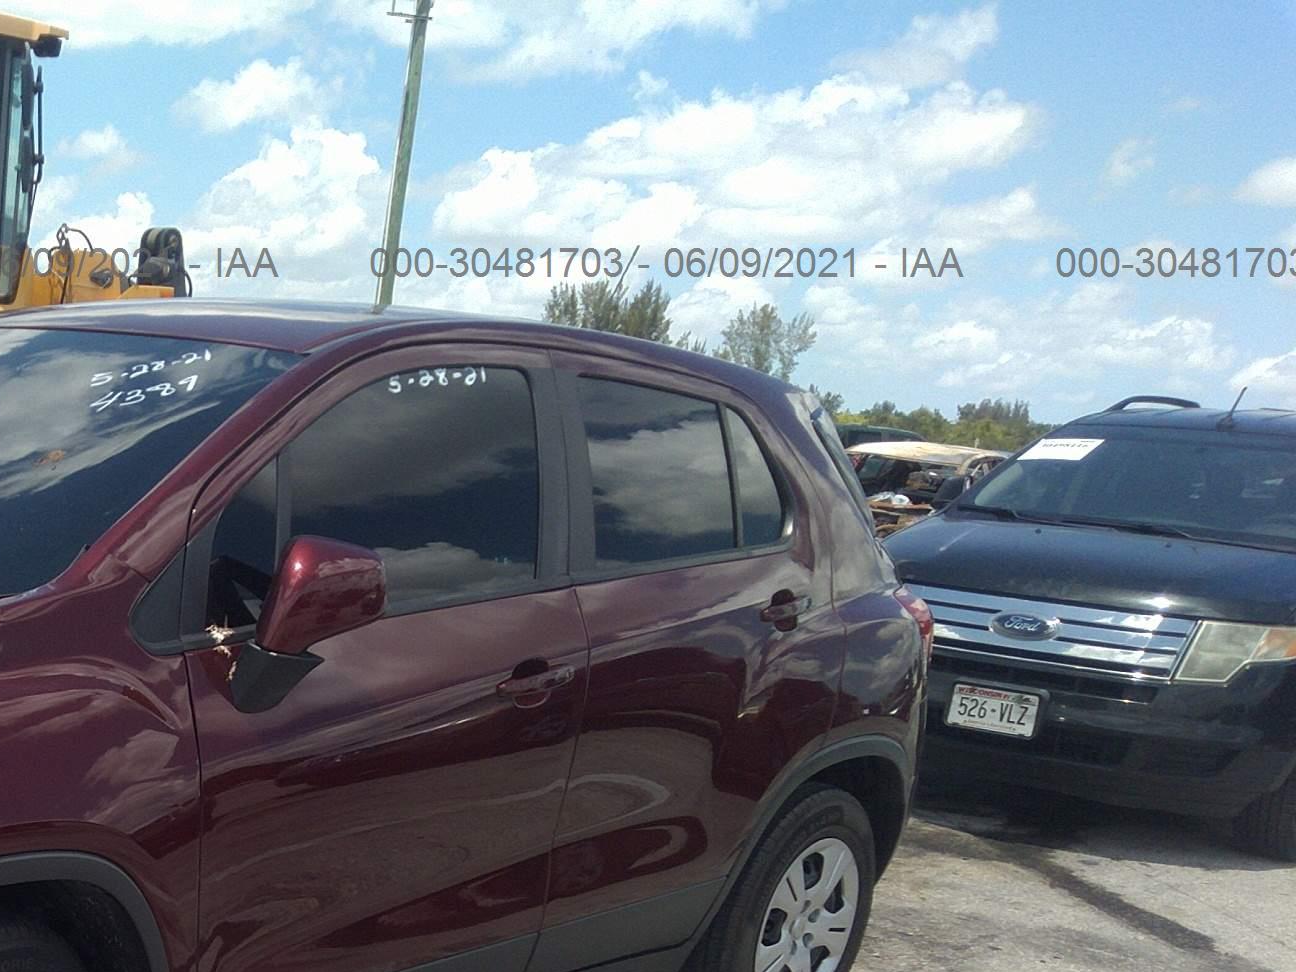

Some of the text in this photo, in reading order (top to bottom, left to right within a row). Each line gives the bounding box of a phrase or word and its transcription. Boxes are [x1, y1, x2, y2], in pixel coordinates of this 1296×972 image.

[89, 374, 199, 413] 4389
[1004, 615, 1041, 632] Ford
[957, 696, 1029, 726] 526-VLZ
